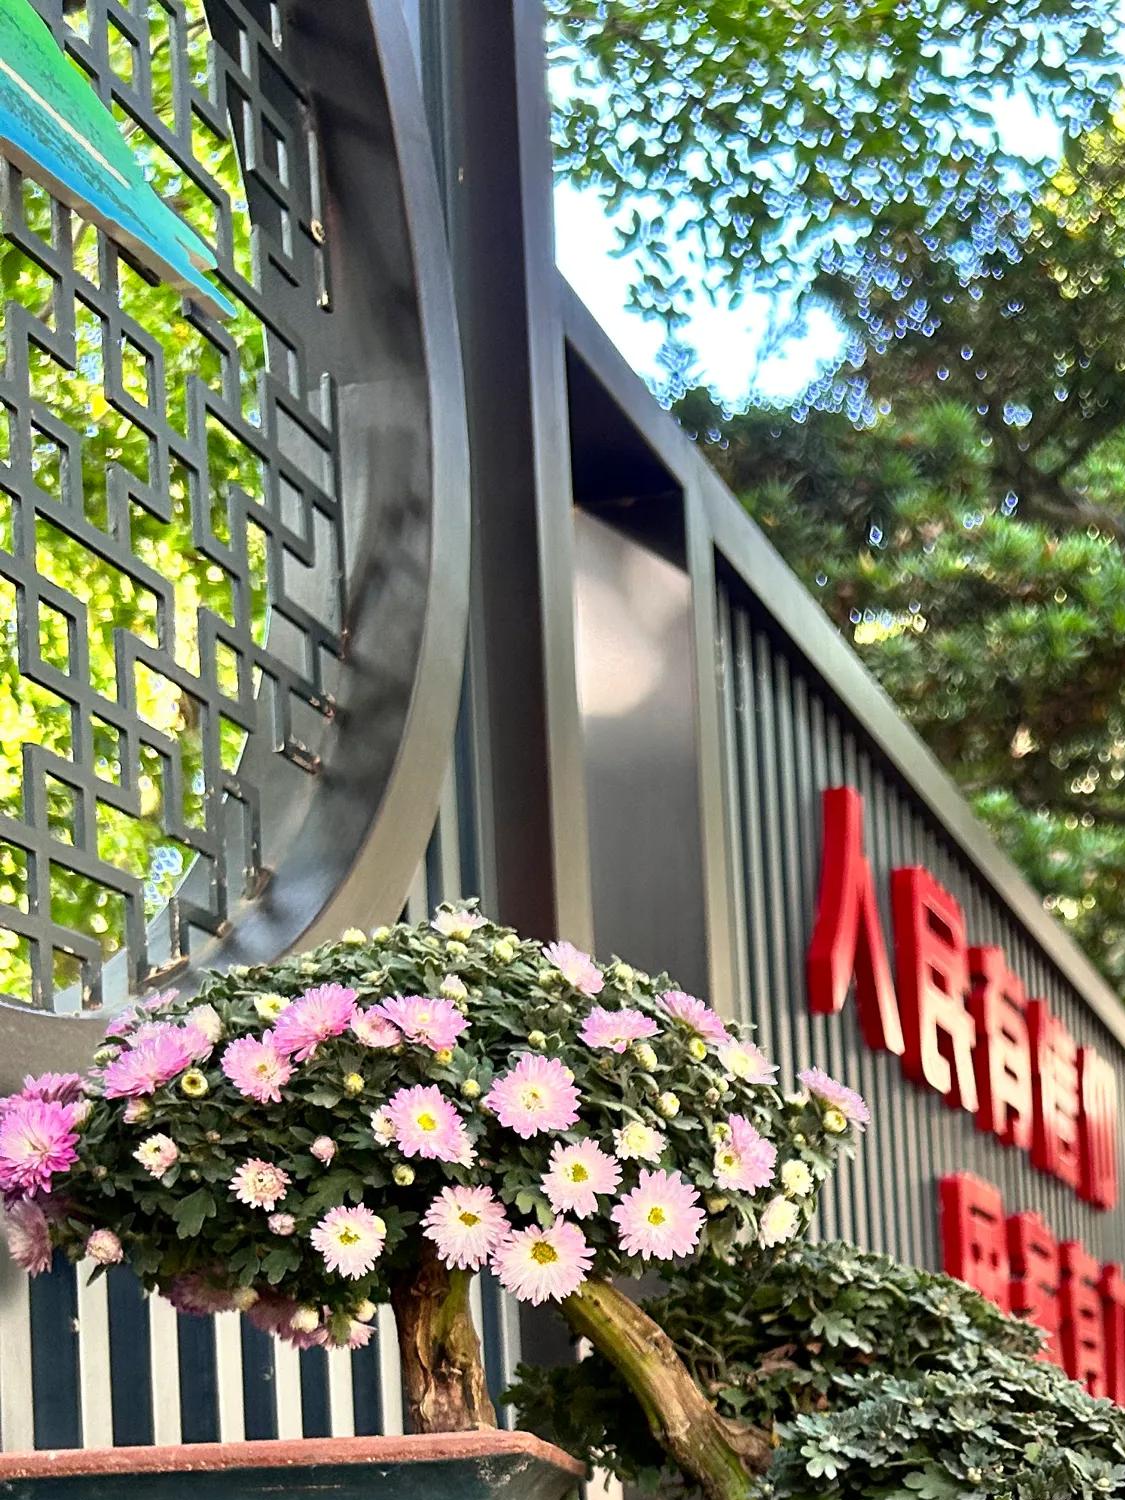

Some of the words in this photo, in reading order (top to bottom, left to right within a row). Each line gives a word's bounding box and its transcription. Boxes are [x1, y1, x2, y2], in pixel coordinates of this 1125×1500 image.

[808, 786, 1117, 1210] 人民有信仰
